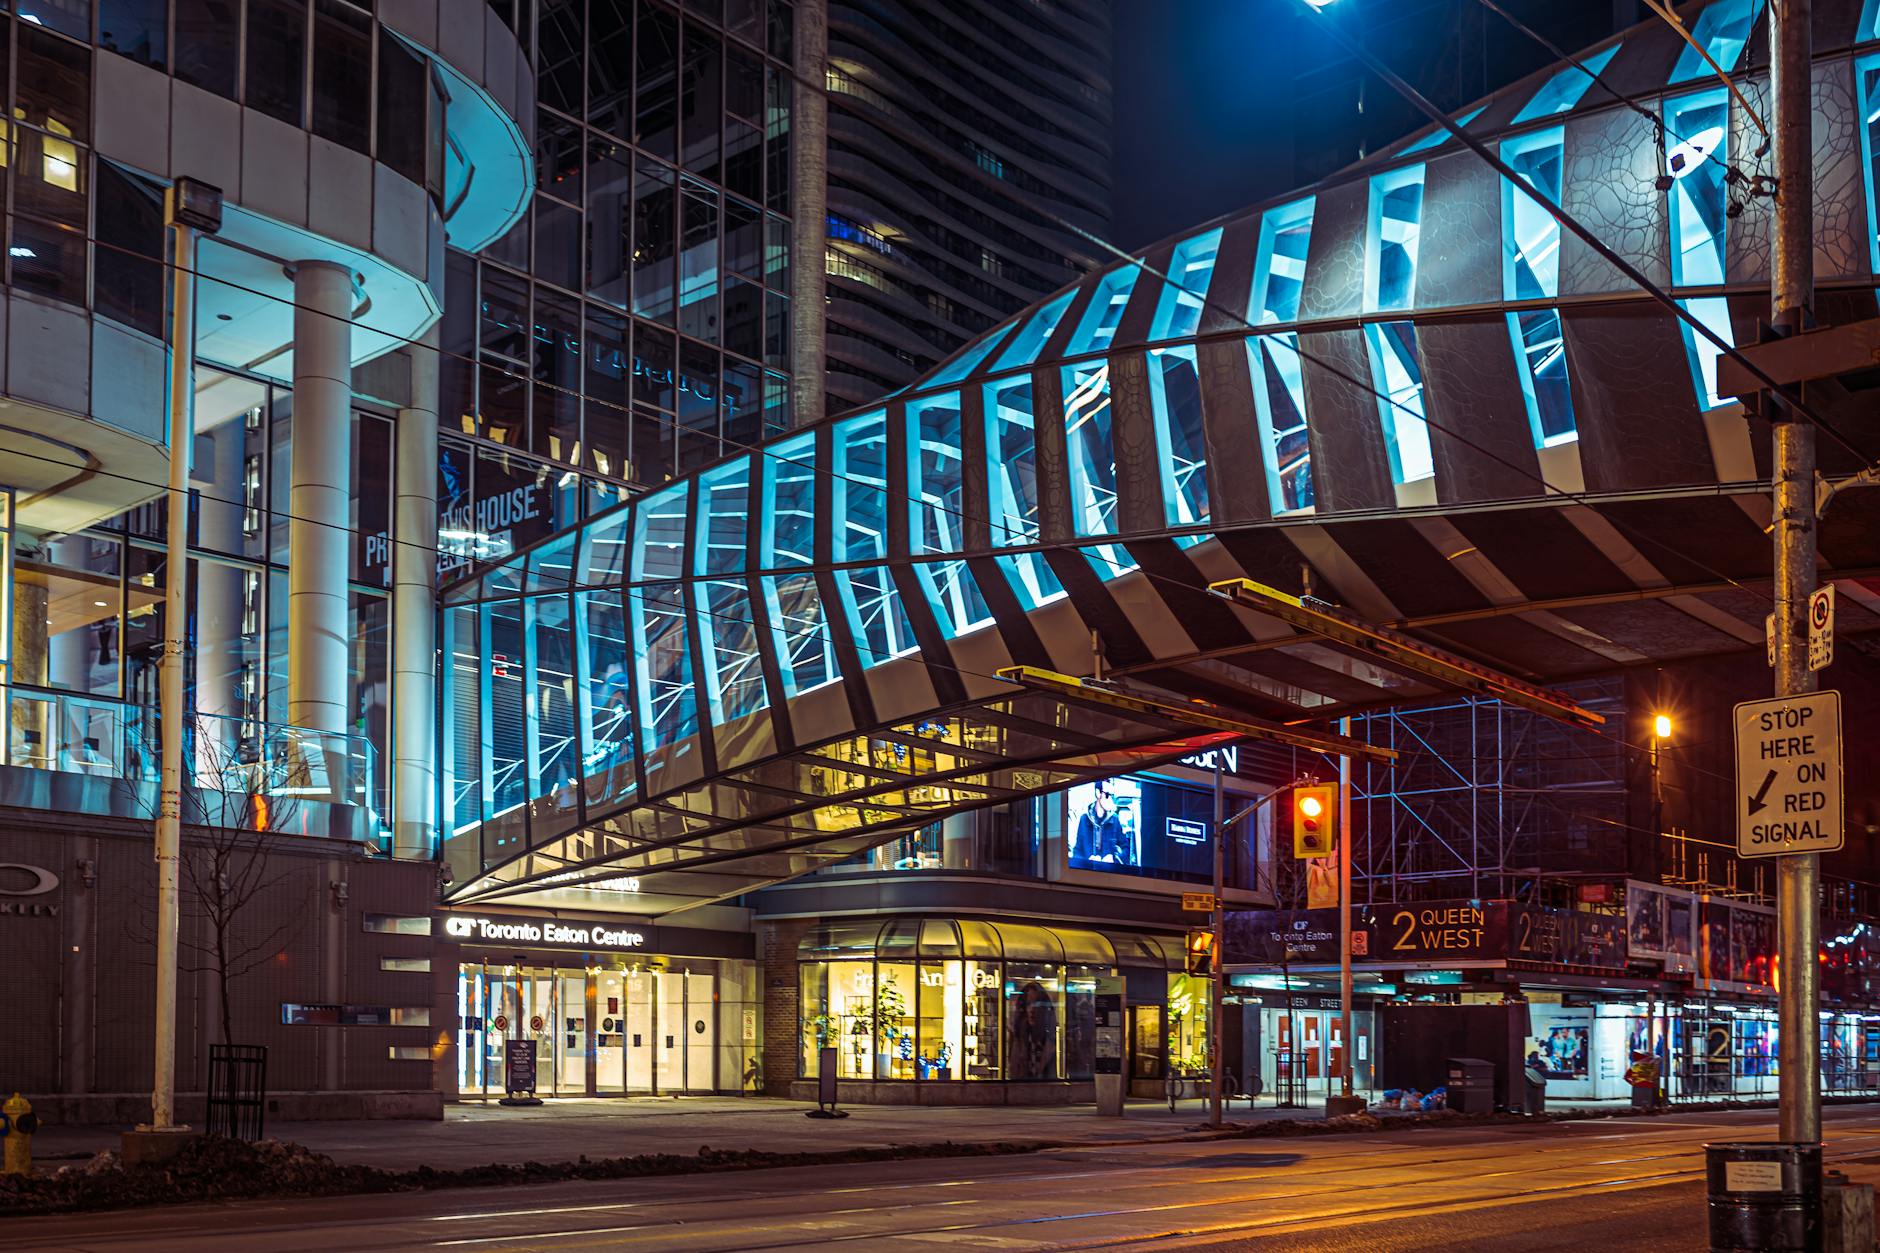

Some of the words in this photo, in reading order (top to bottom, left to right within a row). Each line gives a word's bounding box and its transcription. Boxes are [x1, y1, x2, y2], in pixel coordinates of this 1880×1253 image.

[476, 483, 540, 531] HOUSE.
[1760, 707, 1813, 732] STOP
[1760, 735, 1815, 760] HERE
[1797, 762, 1825, 784] ON
[1784, 791, 1825, 813] RED
[1751, 820, 1828, 844] SIGNAL
[1420, 907, 1485, 926] QUEEN
[477, 918, 541, 942] Toronto
[543, 923, 589, 945] Eaton
[591, 926, 644, 947] Centre
[1306, 931, 1333, 941] Eaton
[1391, 910, 1417, 951] 2
[1420, 928, 1485, 950] WEST
[1519, 911, 1531, 952] 2
[1286, 943, 1317, 952] Centre
